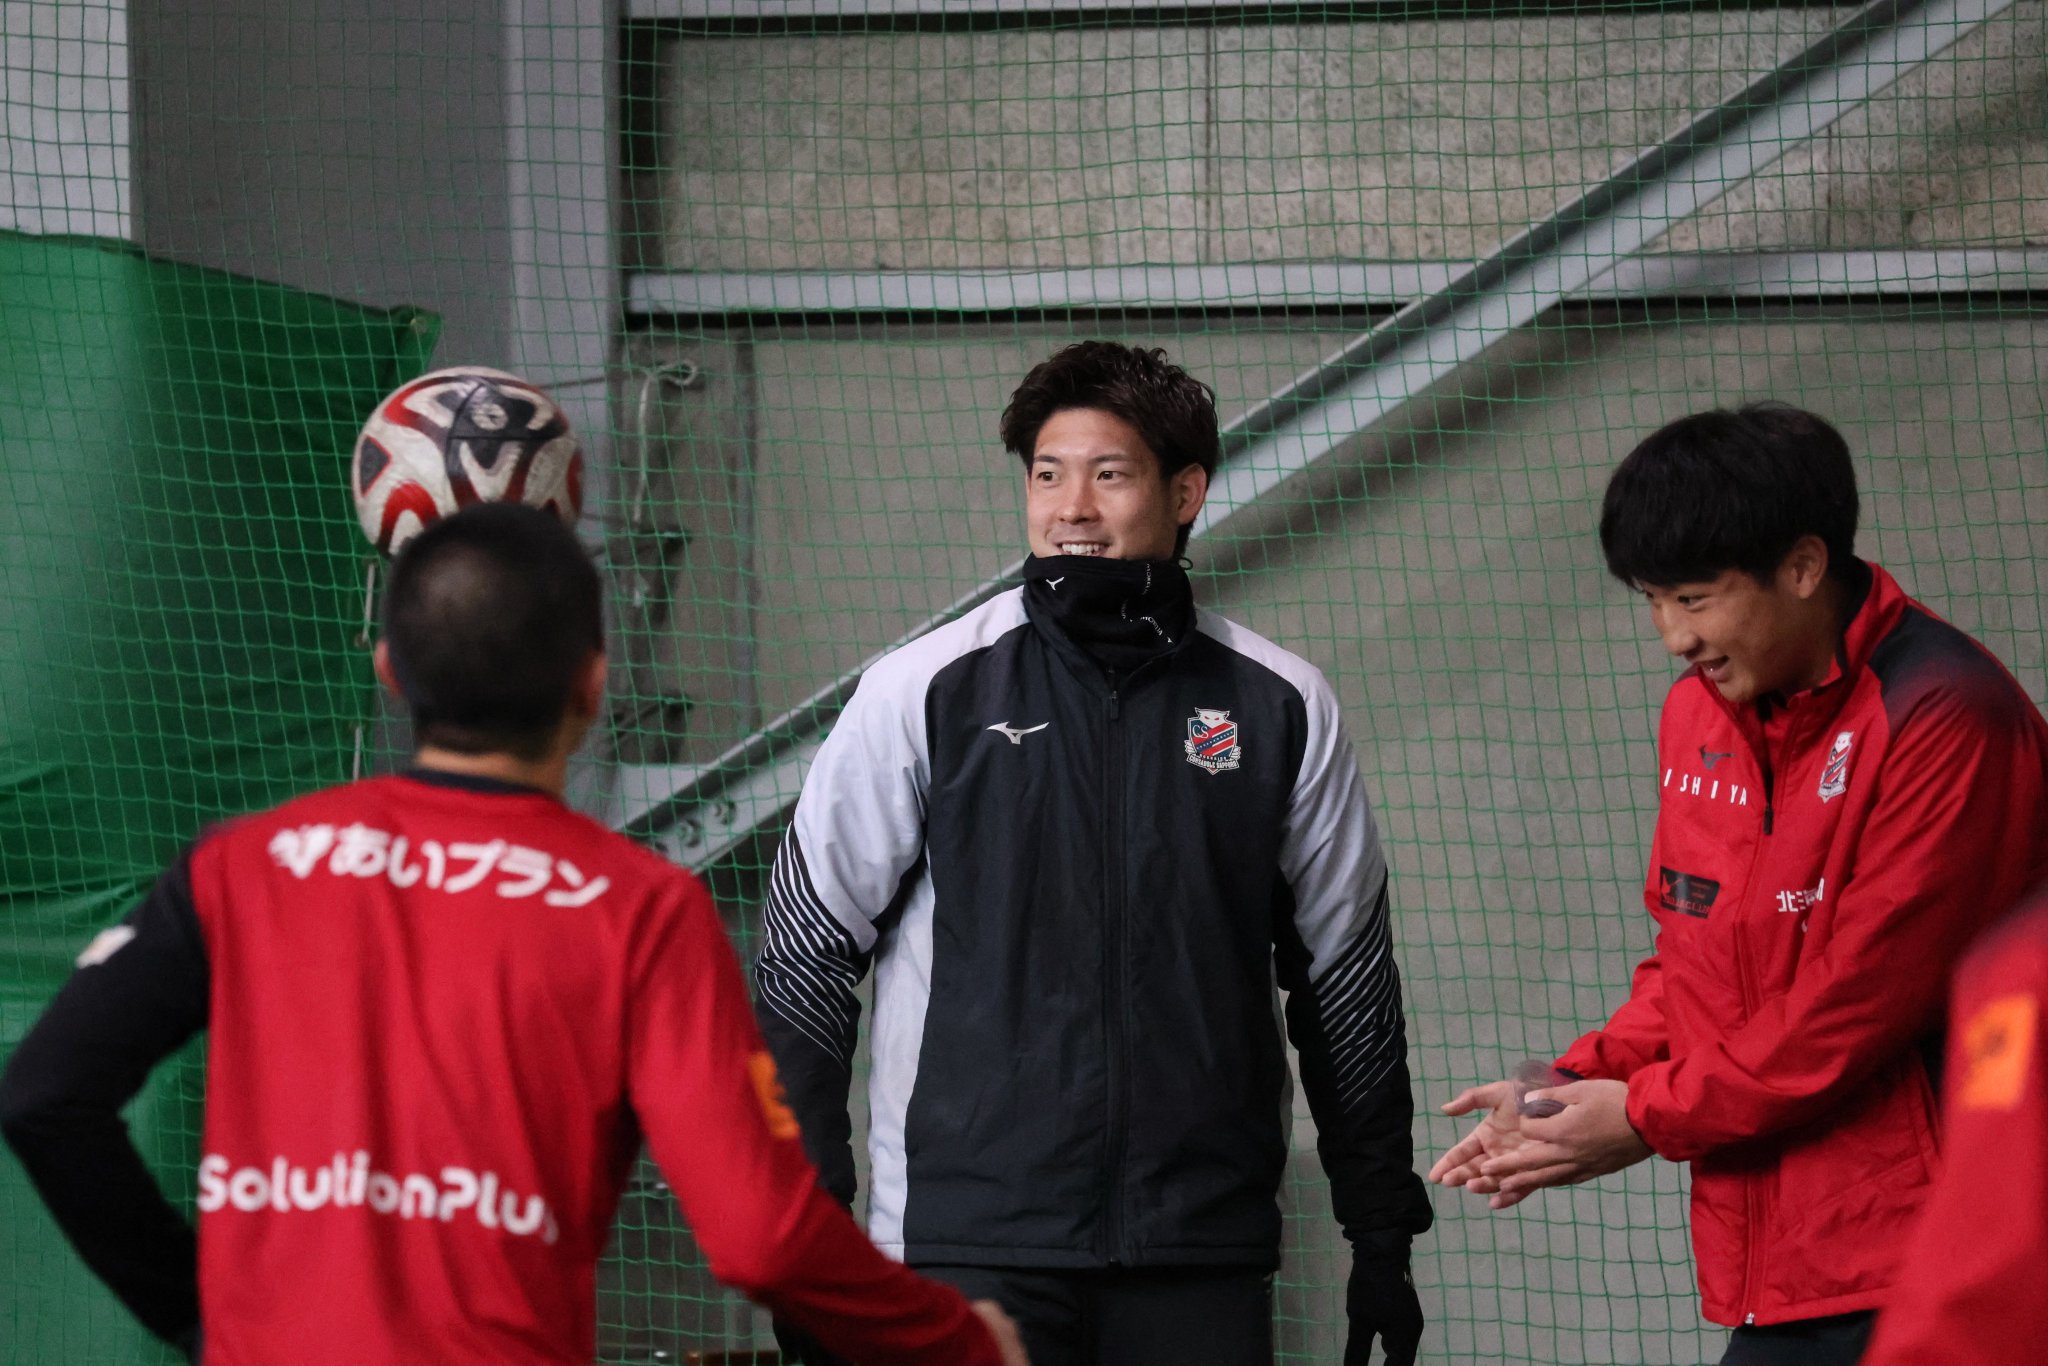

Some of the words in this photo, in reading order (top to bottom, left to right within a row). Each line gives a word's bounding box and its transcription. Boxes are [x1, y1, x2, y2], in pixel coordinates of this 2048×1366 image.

[1663, 768, 1748, 806] ISHIYA
[328, 822, 611, 907] あいプラン
